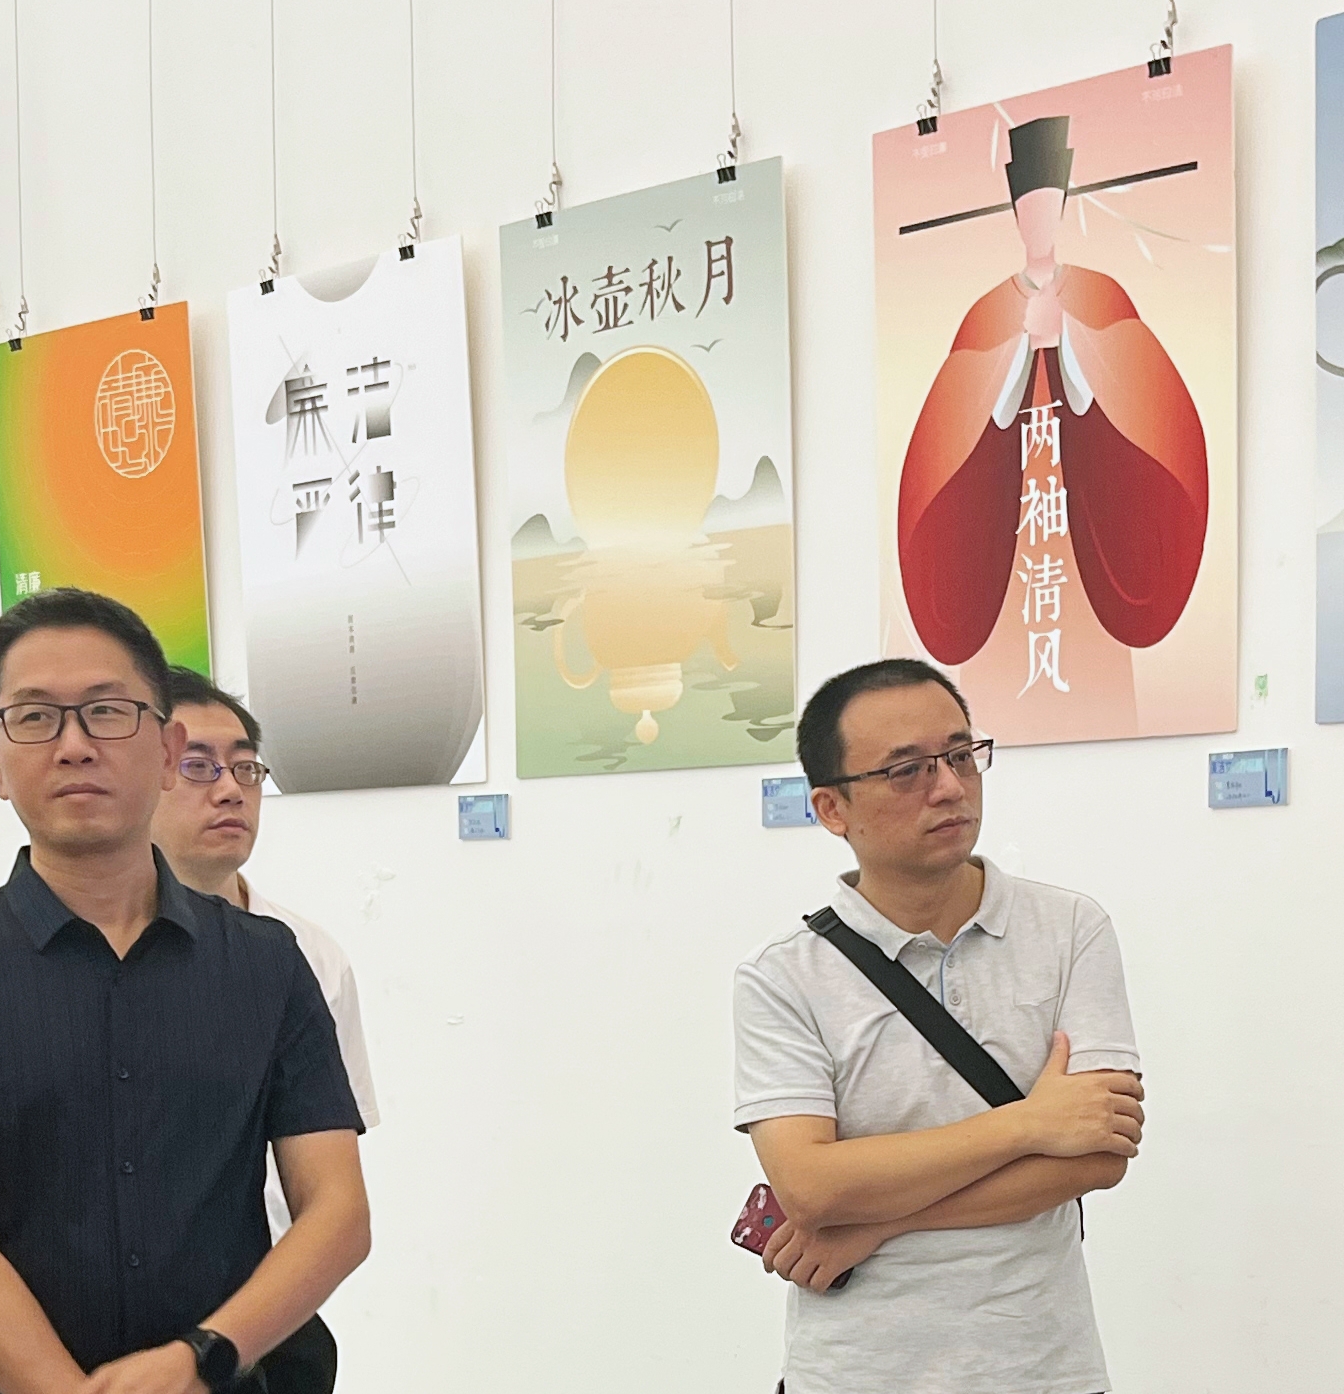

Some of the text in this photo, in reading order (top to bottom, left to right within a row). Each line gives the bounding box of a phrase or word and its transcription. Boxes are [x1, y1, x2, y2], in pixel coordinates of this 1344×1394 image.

[541, 234, 738, 343] 冰壶秋月
[1015, 398, 1072, 701] 两袖清风
